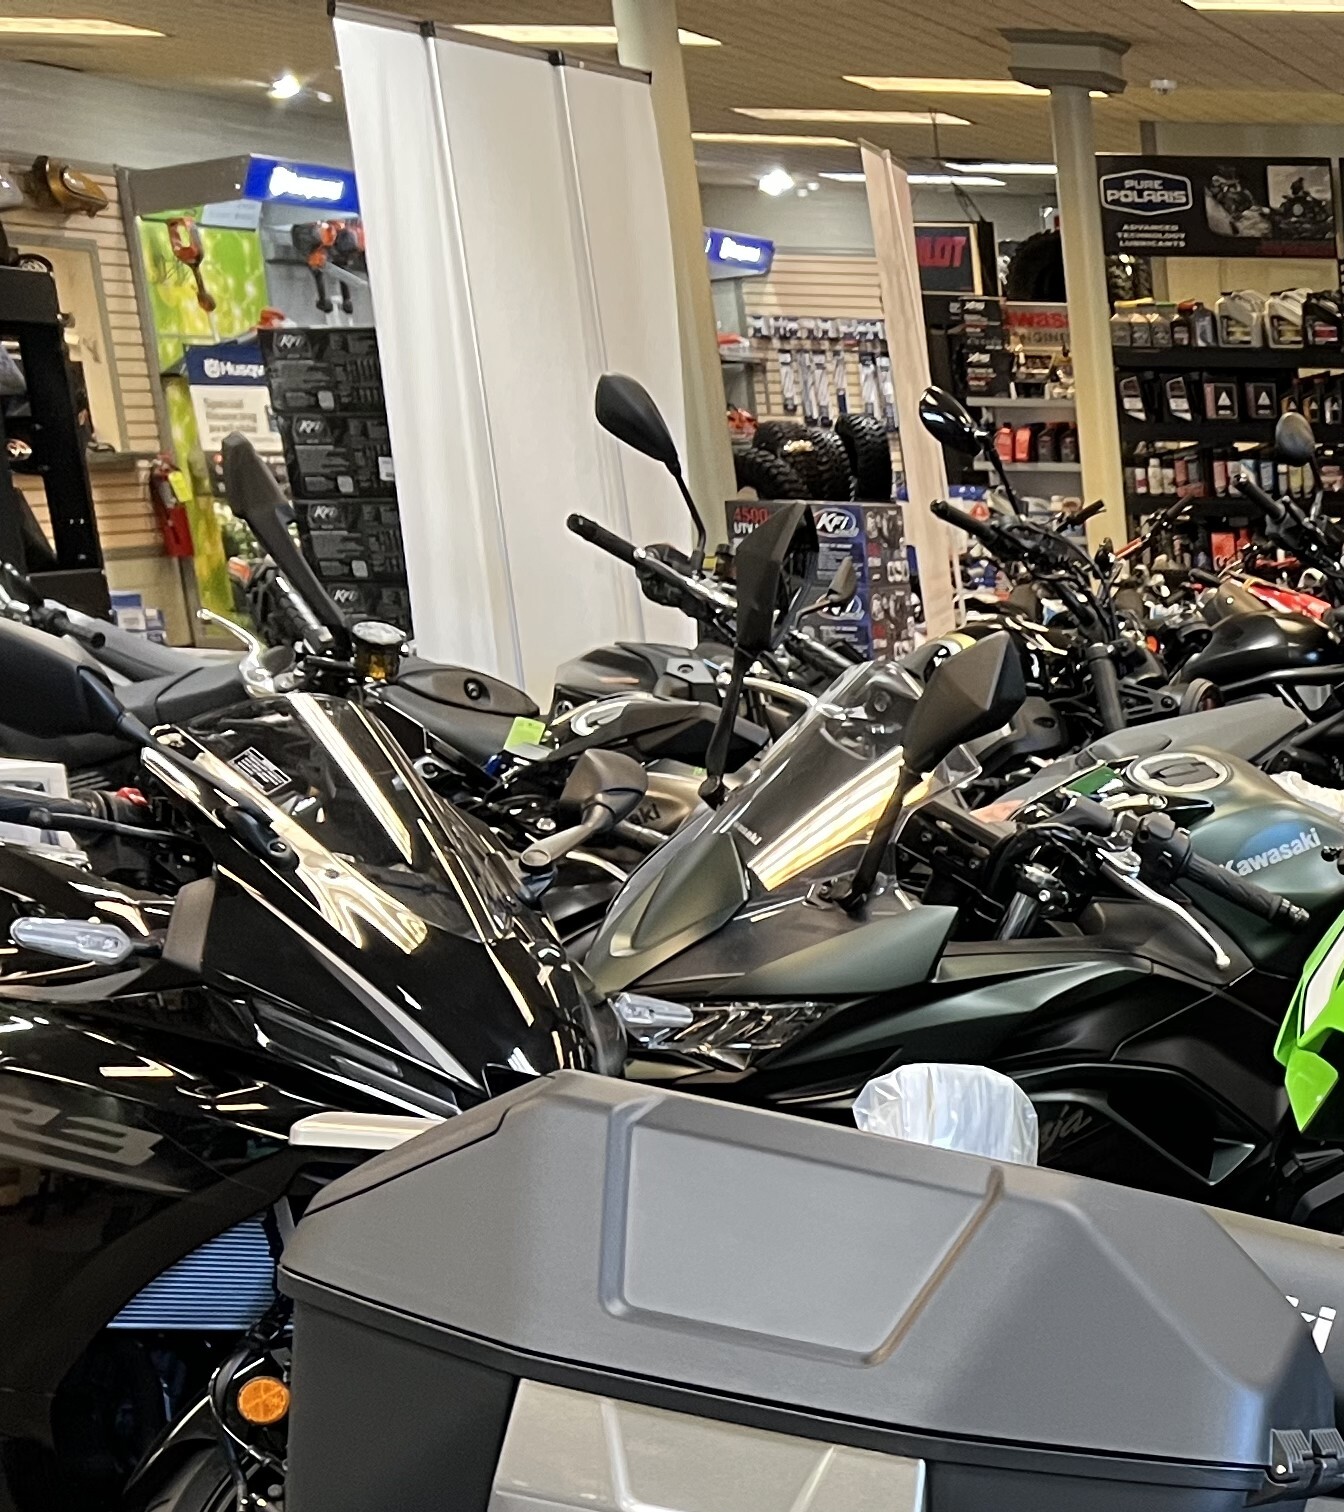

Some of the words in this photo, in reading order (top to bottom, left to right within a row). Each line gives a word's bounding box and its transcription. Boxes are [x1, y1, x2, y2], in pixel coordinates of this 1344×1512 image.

[1124, 179, 1164, 190] PURE
[1106, 189, 1188, 204] POLARIS
[815, 512, 850, 533] KFI
